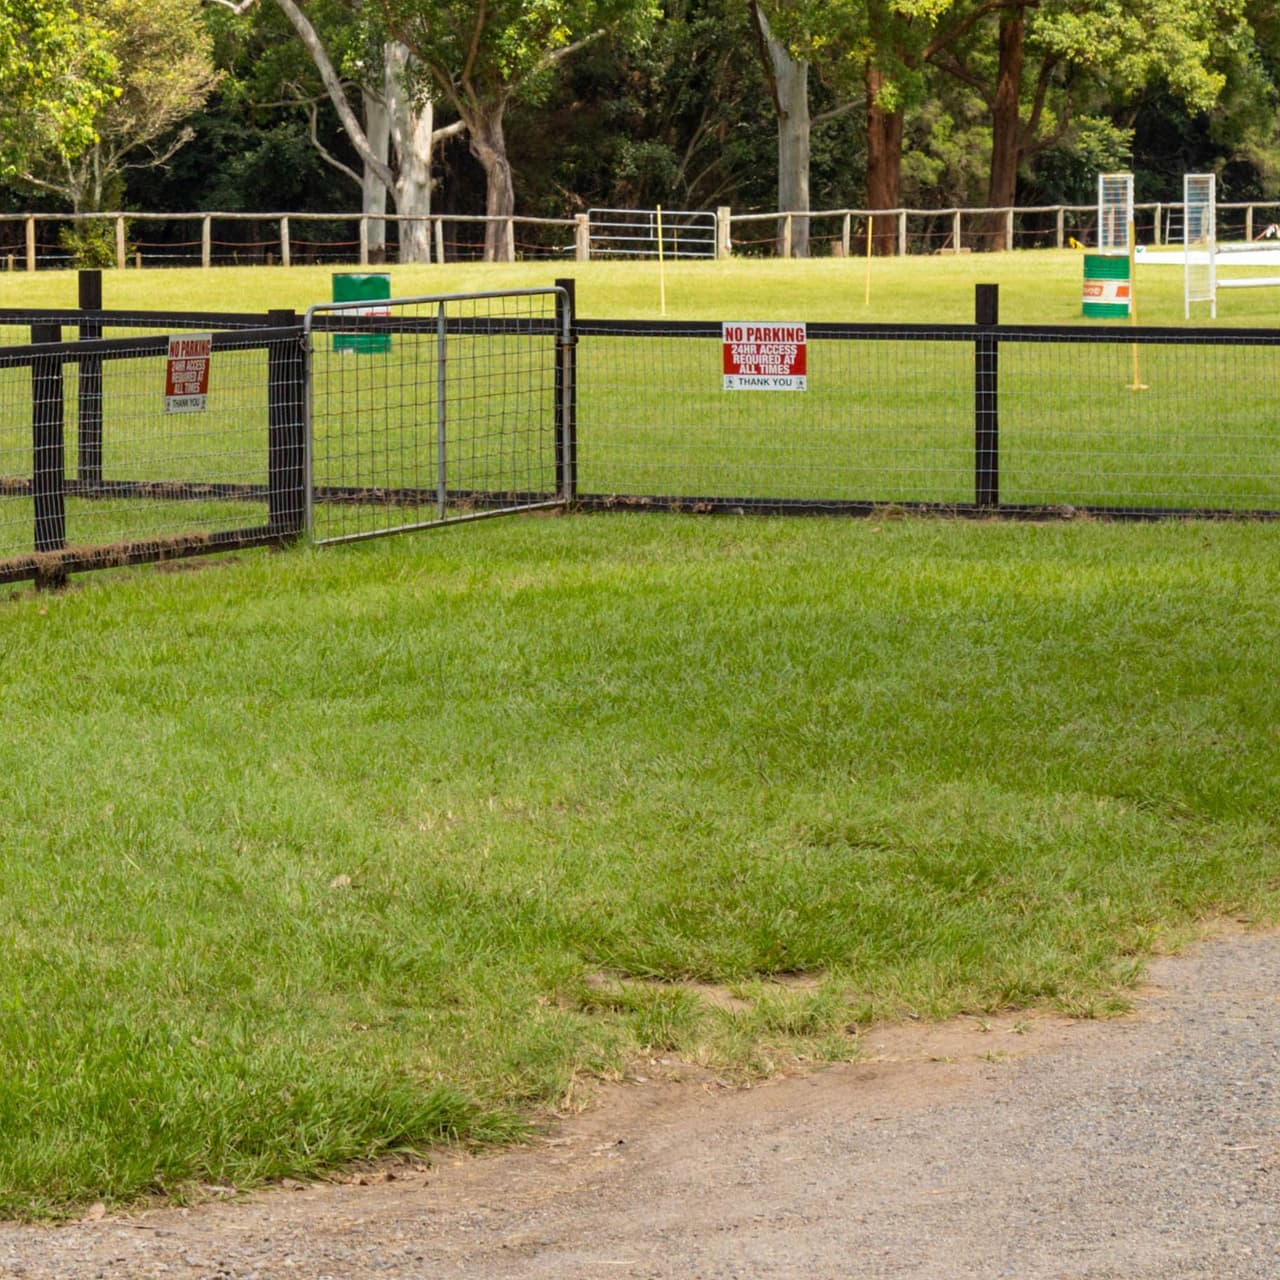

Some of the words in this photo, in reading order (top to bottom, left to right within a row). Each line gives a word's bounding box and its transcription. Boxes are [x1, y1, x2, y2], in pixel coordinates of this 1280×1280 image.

[726, 327, 742, 341] NO
[747, 327, 804, 342] PARKING
[170, 341, 179, 357] NO
[181, 340, 209, 357] PARKING
[731, 345, 757, 354] 24HR
[760, 345, 797, 354] ACCESS
[733, 355, 780, 365] REQUIRED
[784, 355, 795, 364] AT
[739, 365, 757, 374] ALL
[760, 365, 789, 374] TIMES
[739, 378, 769, 386] THANK
[773, 378, 792, 386] YOU
